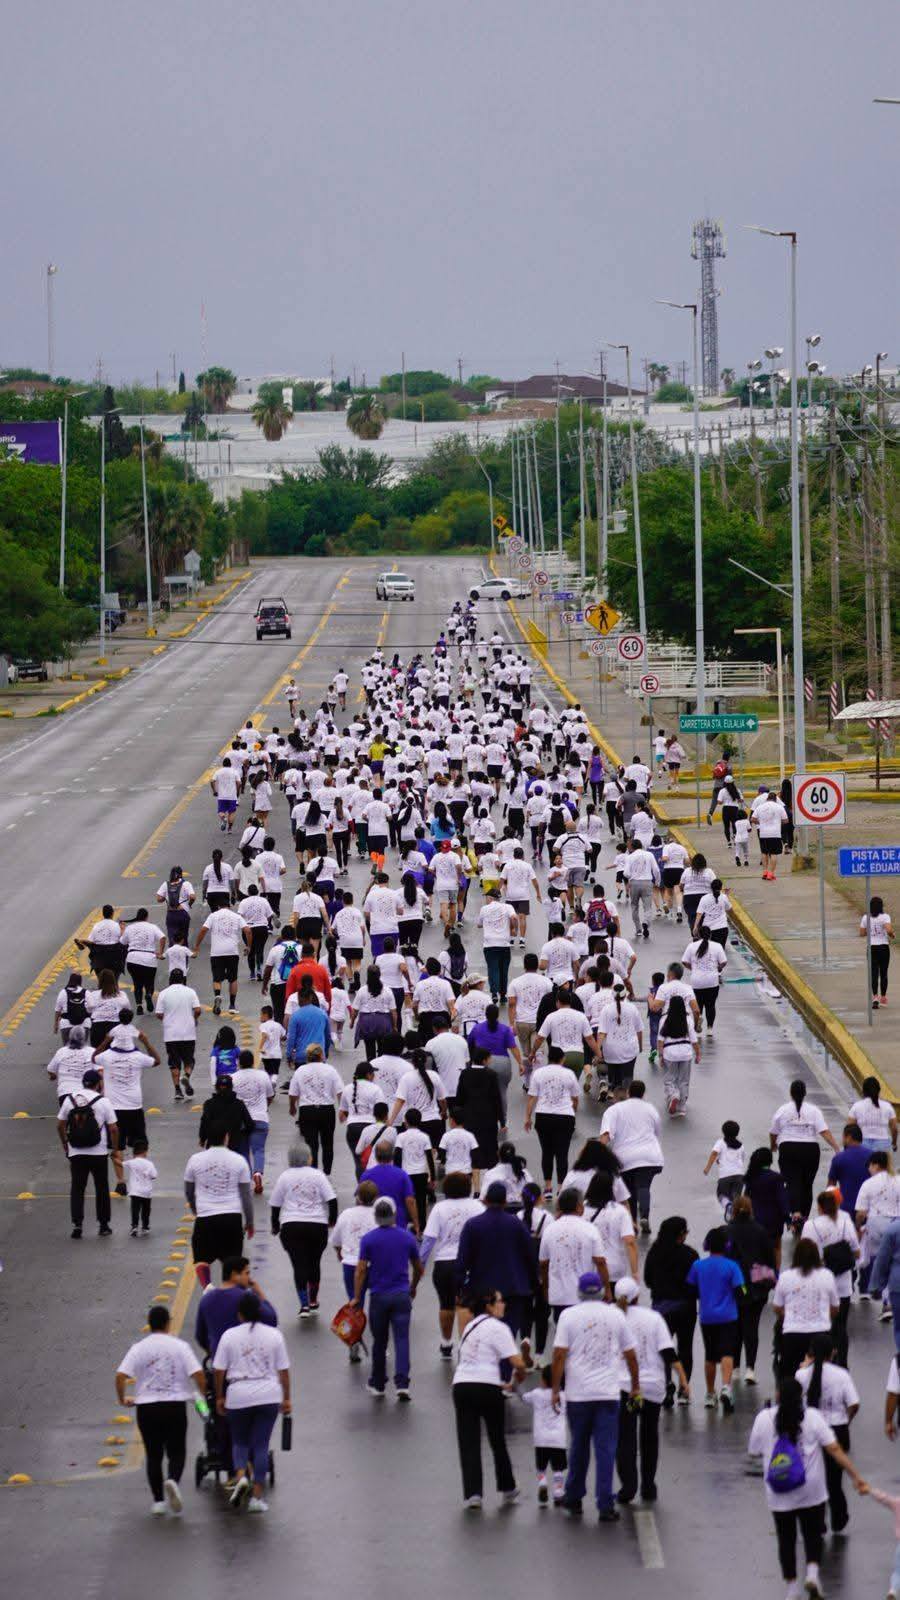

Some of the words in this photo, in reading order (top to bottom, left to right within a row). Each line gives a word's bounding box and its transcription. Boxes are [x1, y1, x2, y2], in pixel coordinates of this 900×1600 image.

[595, 643, 603, 651] 60
[624, 641, 638, 652] 60
[645, 678, 653, 690] E
[680, 719, 710, 729] CARRETERA
[723, 719, 745, 729] EULALIA
[810, 786, 828, 804] 60
[851, 850, 880, 861] PISTA
[881, 850, 895, 860] DE
[851, 863, 868, 873] LIC.
